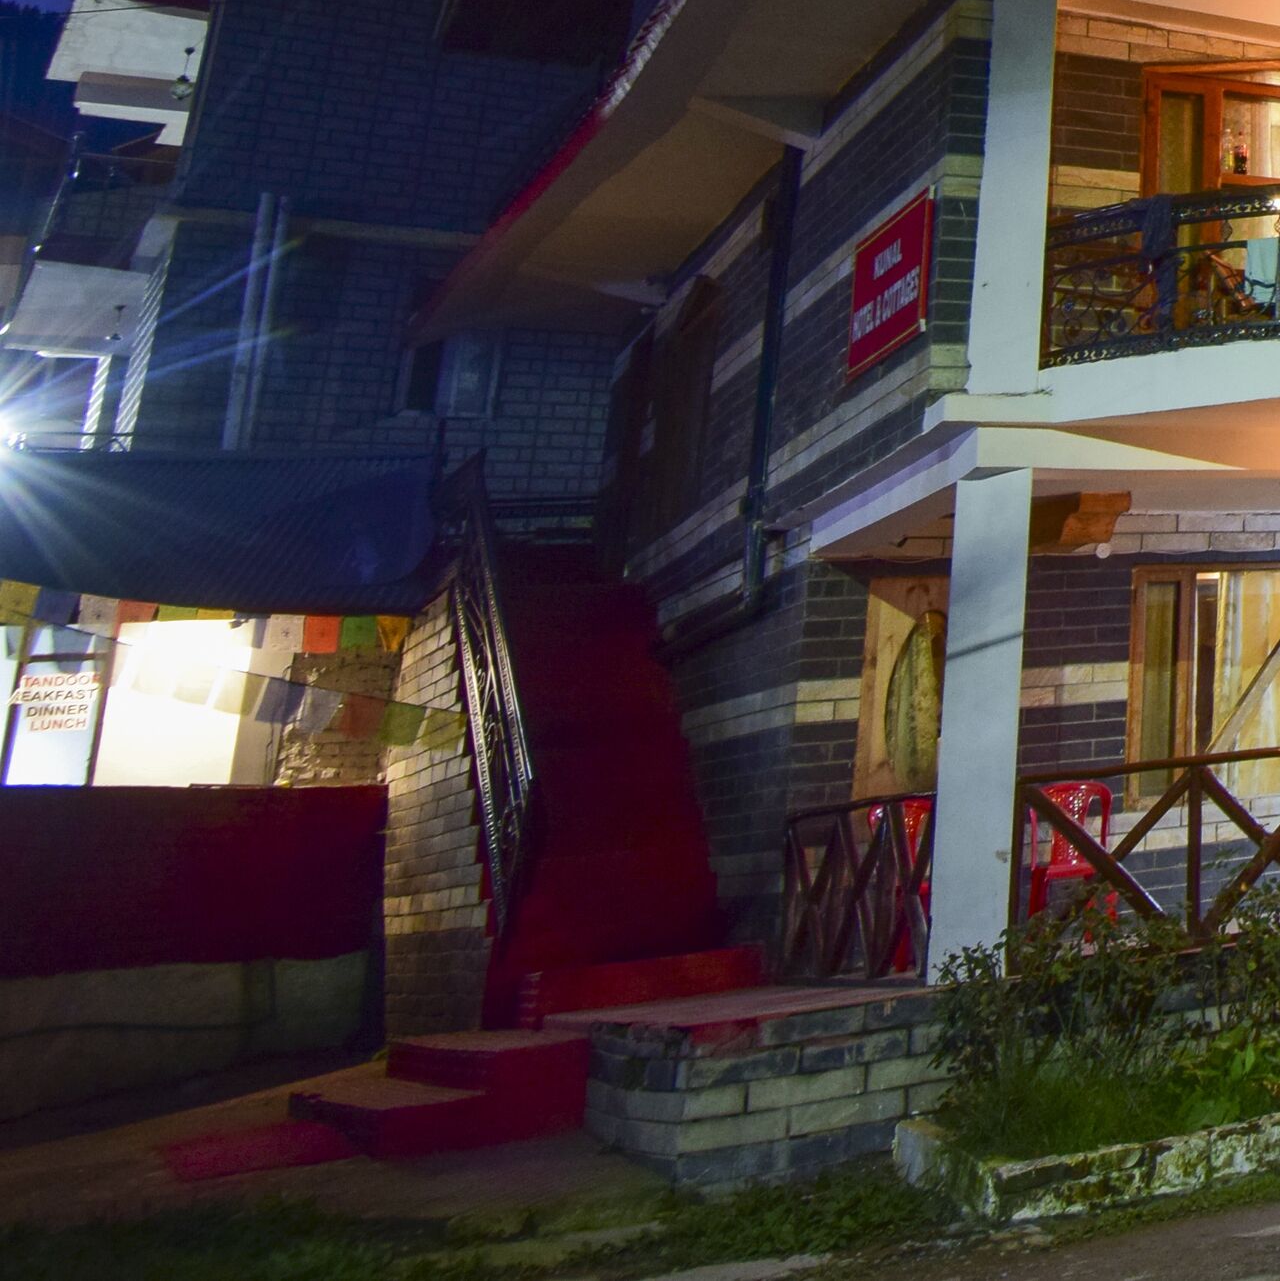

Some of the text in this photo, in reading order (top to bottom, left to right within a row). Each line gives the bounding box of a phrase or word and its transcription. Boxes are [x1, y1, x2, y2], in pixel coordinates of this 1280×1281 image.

[873, 238, 902, 280] KUNAL
[852, 300, 874, 343] HOTEL
[882, 265, 920, 322] COTTAGES
[26, 704, 88, 717] DINNER
[29, 718, 87, 732] LUNCH
